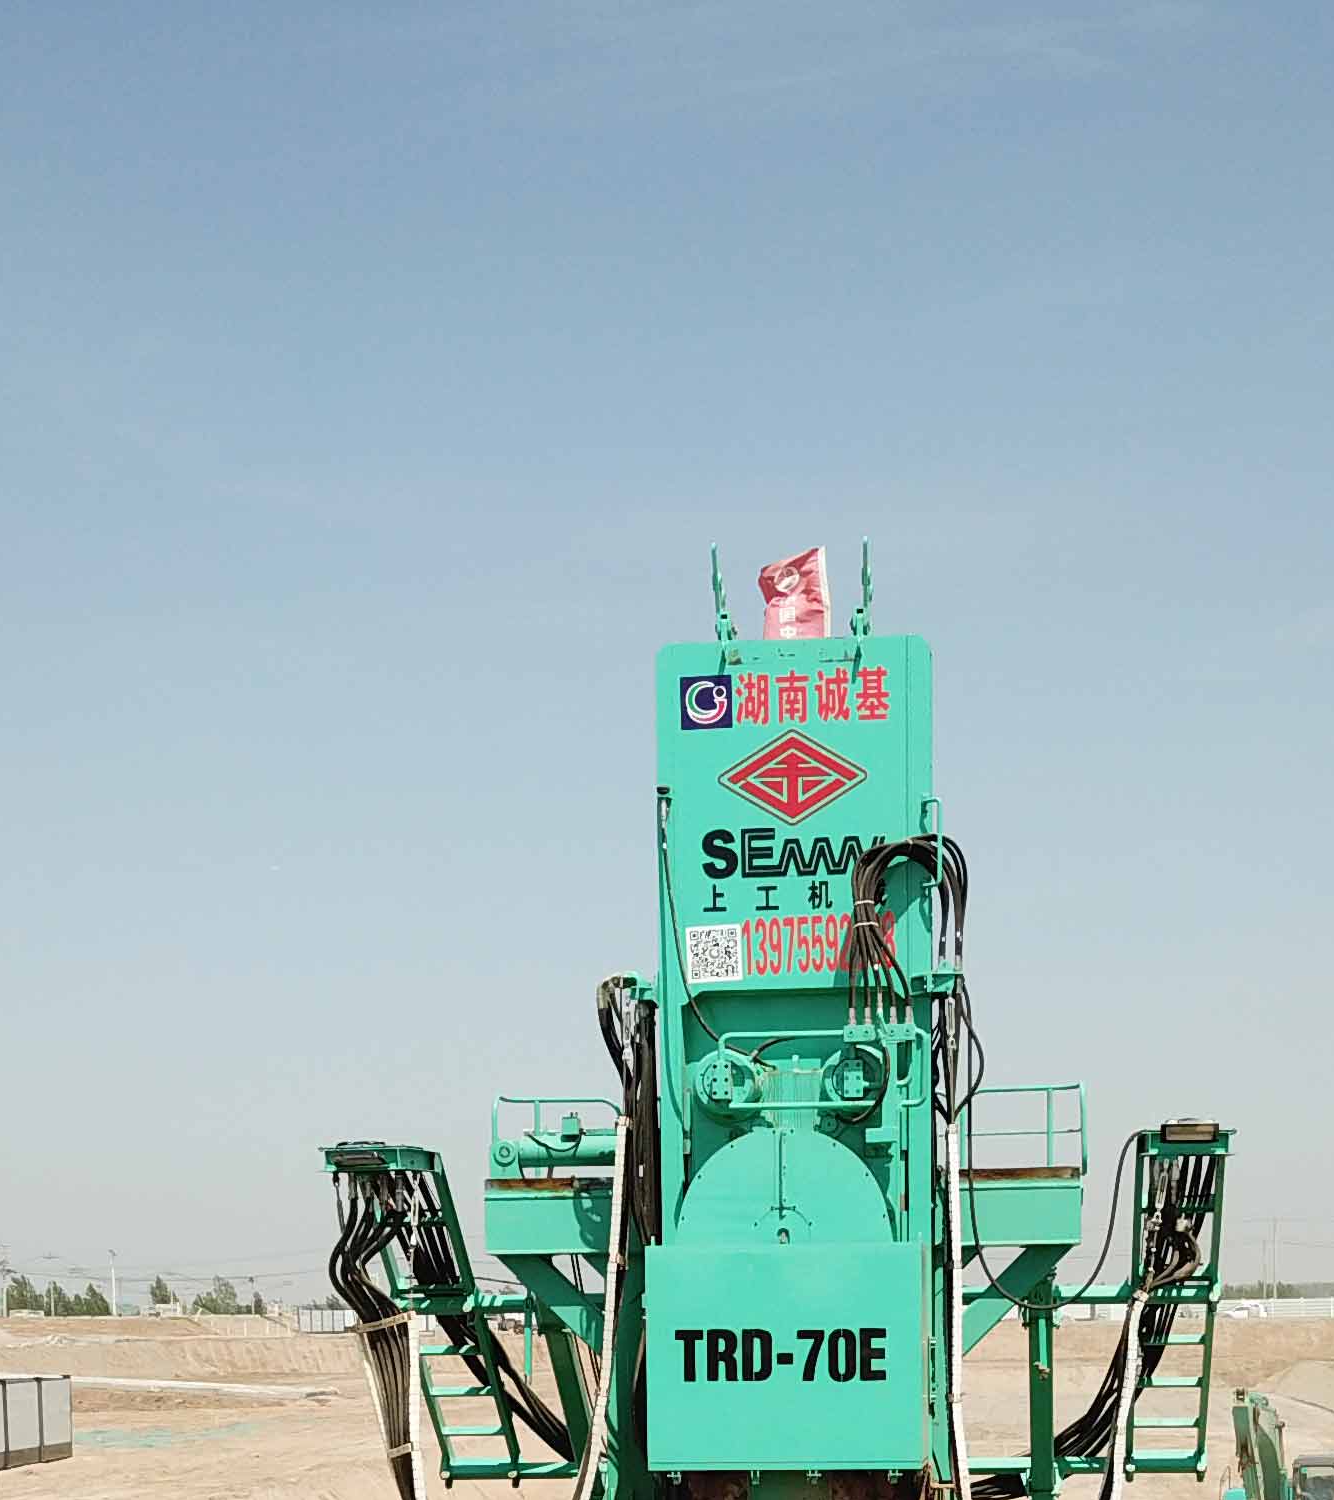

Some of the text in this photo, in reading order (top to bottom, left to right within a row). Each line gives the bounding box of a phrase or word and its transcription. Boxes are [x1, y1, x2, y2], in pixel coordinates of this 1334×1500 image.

[735, 666, 890, 725] 湖南诚基
[703, 880, 886, 913] 上工机
[742, 910, 896, 976] 139755928
[675, 1328, 886, 1382] TRD-70E
